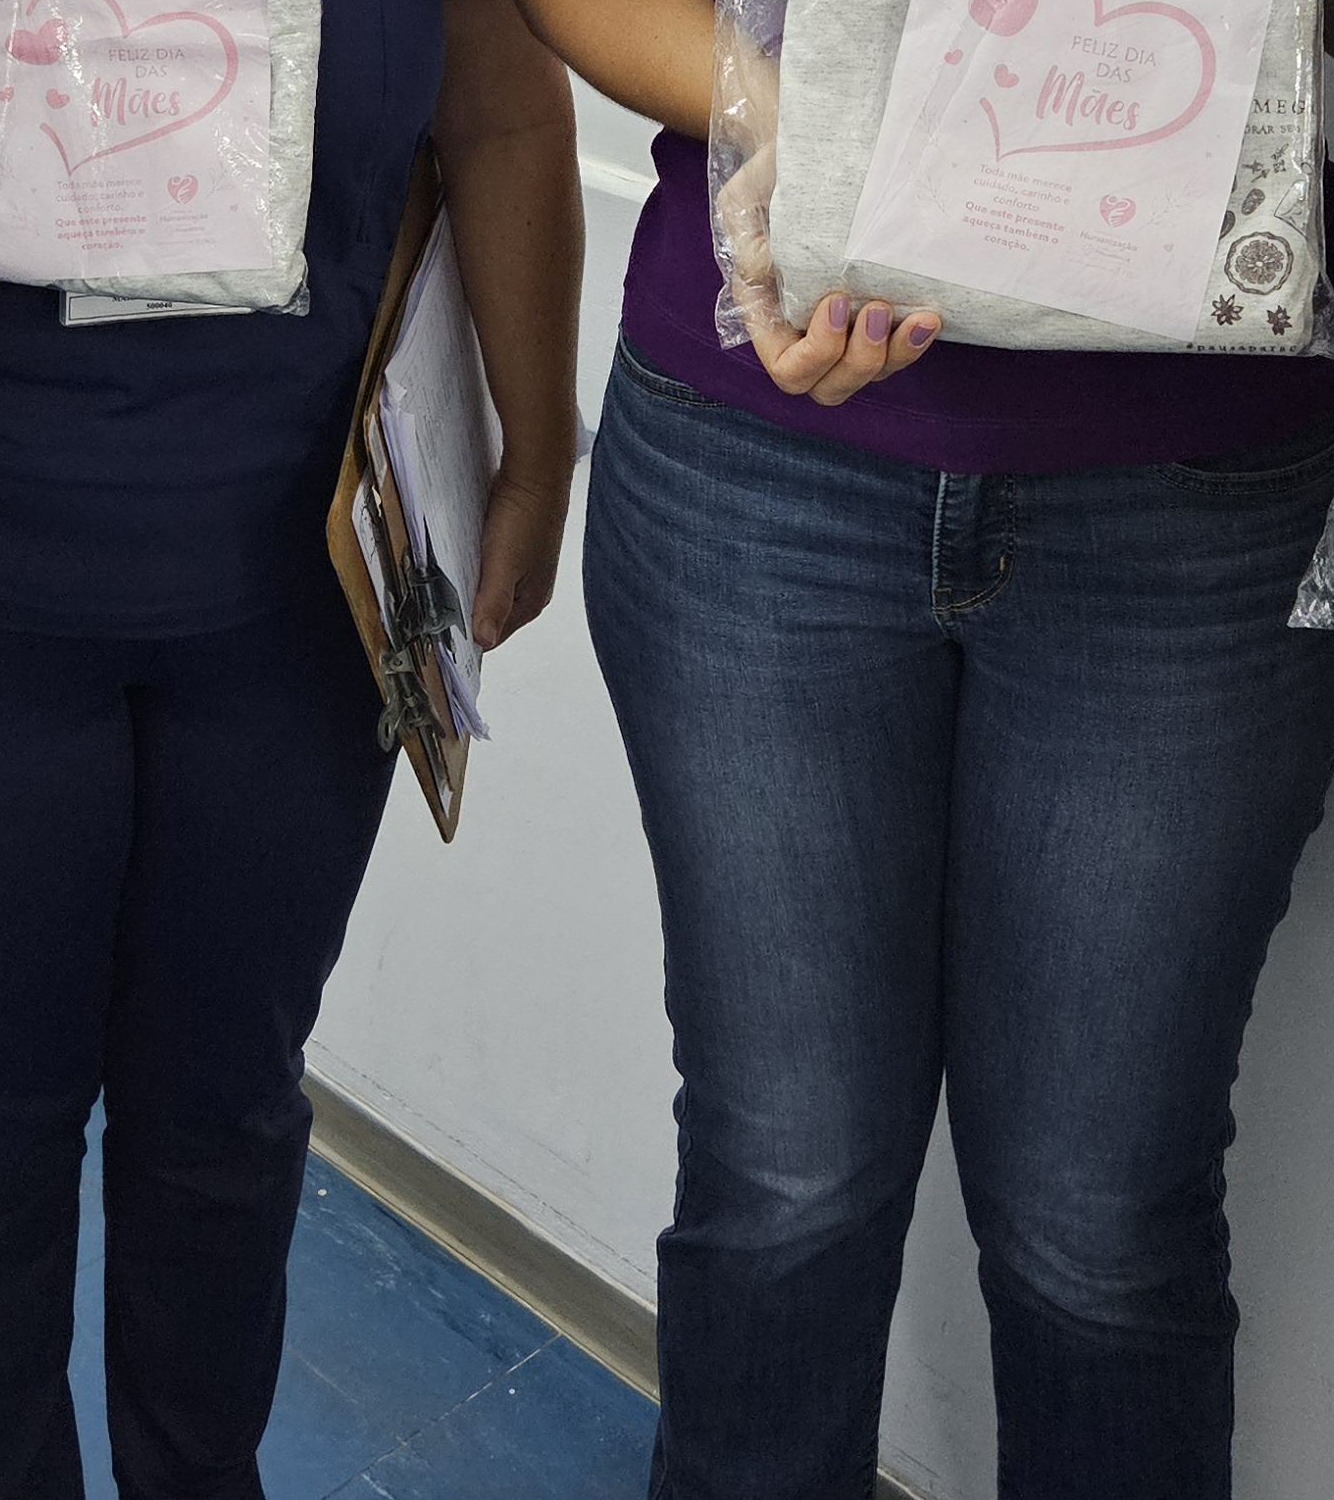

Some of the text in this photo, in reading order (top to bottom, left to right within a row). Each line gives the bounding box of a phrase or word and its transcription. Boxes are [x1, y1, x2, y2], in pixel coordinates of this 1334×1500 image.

[108, 48, 185, 61] FELIZ DIA
[1071, 35, 1156, 67] FELIZ DIA
[135, 65, 167, 78] DAS
[1096, 62, 1132, 83] DAS
[91, 77, 180, 127] Mães
[1035, 64, 1140, 131] Mães
[57, 181, 80, 190] Toda
[106, 179, 142, 187] merece
[980, 164, 1072, 193] Toda mãe merece
[973, 178, 1018, 195] cuidado,
[1021, 188, 1061, 203] carinho
[55, 214, 147, 228] Que este presente
[965, 201, 1065, 232] Que este presente
[57, 230, 93, 240] aqueça
[96, 226, 137, 237] também
[962, 215, 1001, 231] aqueça
[1003, 225, 1049, 243] também
[984, 234, 1030, 252] coração.
